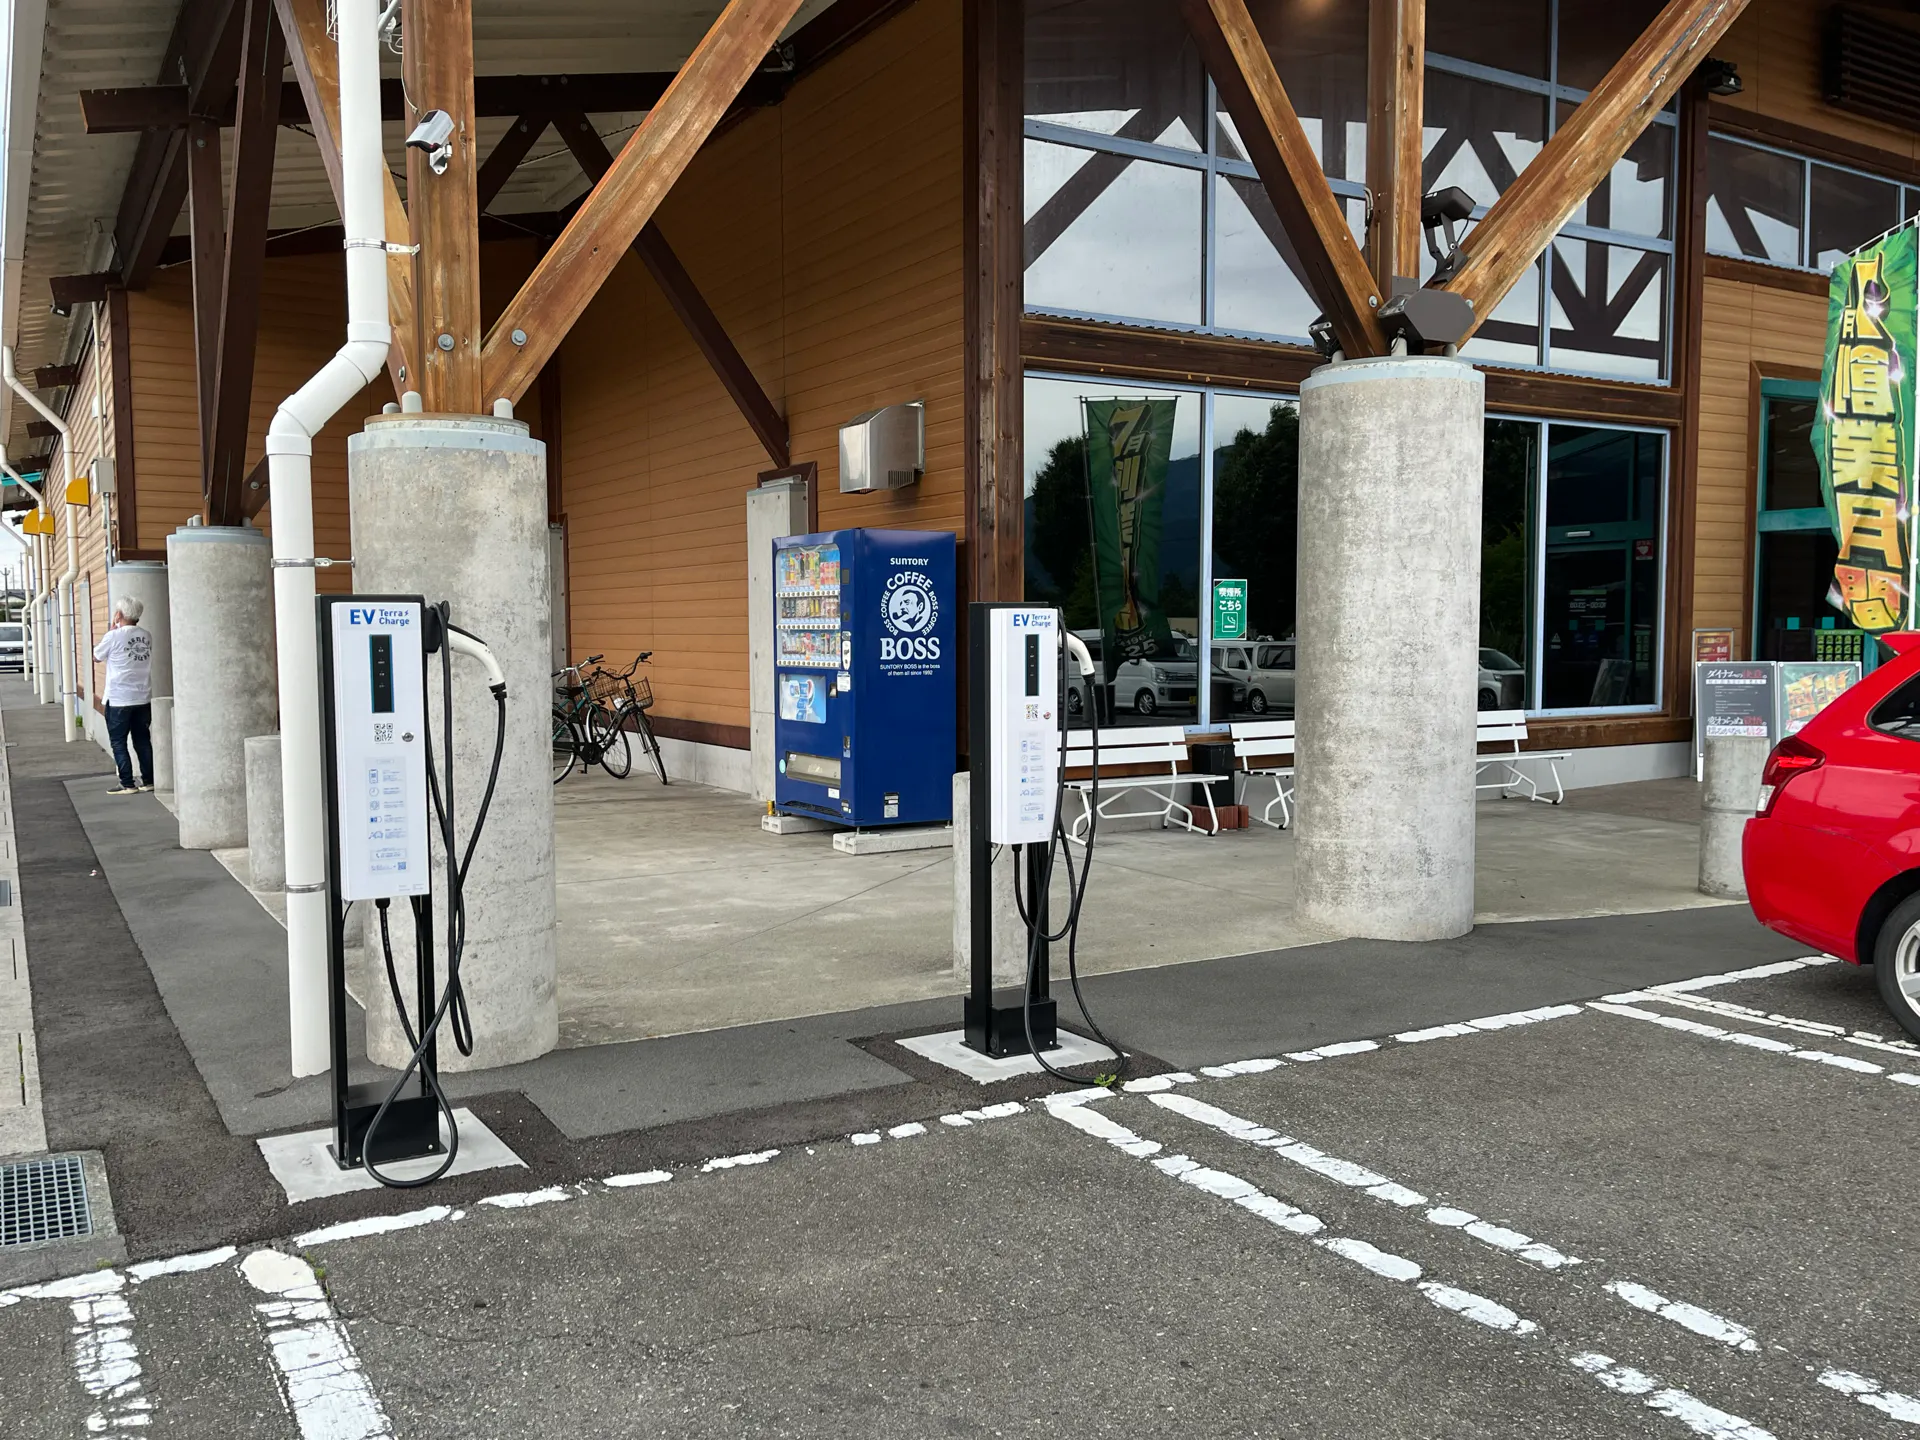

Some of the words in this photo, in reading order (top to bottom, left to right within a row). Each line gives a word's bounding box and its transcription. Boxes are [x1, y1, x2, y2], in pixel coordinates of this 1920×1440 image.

[886, 571, 933, 591] COFFEE
[1219, 600, 1242, 611] こちら
[349, 608, 376, 625] EV
[378, 608, 403, 617] Terra
[378, 617, 410, 627] Charge
[1013, 613, 1030, 627] EV
[1031, 620, 1051, 628] Charge
[880, 637, 941, 661] BOSS
